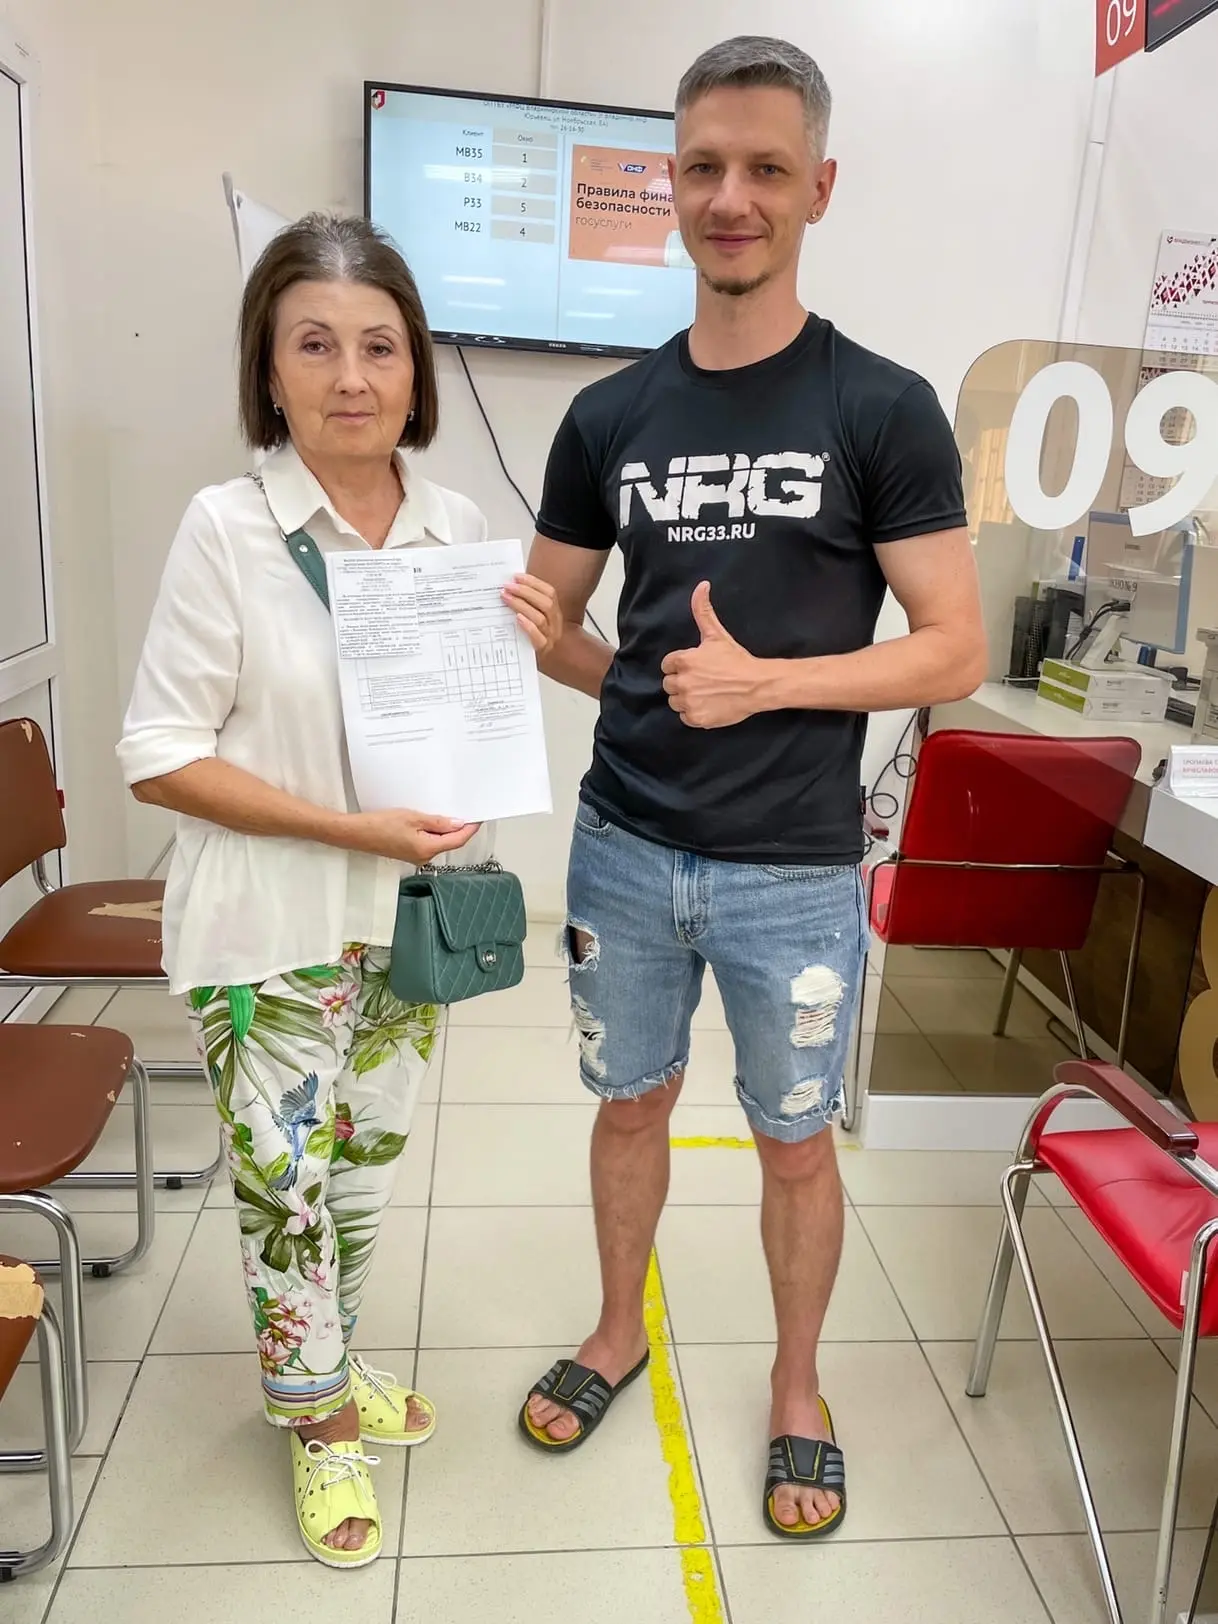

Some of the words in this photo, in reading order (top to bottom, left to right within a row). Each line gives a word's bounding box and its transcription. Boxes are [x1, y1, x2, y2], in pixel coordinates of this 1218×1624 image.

[1106, 0, 1137, 46] 09
[462, 129, 484, 137] Клиент
[517, 134, 534, 143] Окно
[455, 146, 483, 159] МВ35
[522, 153, 528, 164] 1
[521, 177, 527, 188] 2
[577, 183, 636, 199] Правила
[463, 196, 482, 208] Р33
[520, 202, 527, 213] 5
[576, 197, 671, 217] безопасности
[454, 220, 482, 233] МВ22
[575, 216, 633, 231] госуслуги
[519, 227, 526, 237] 4
[1004, 361, 1218, 537] 09
[620, 451, 825, 529] NRG
[667, 523, 756, 542] NRG33.RU
